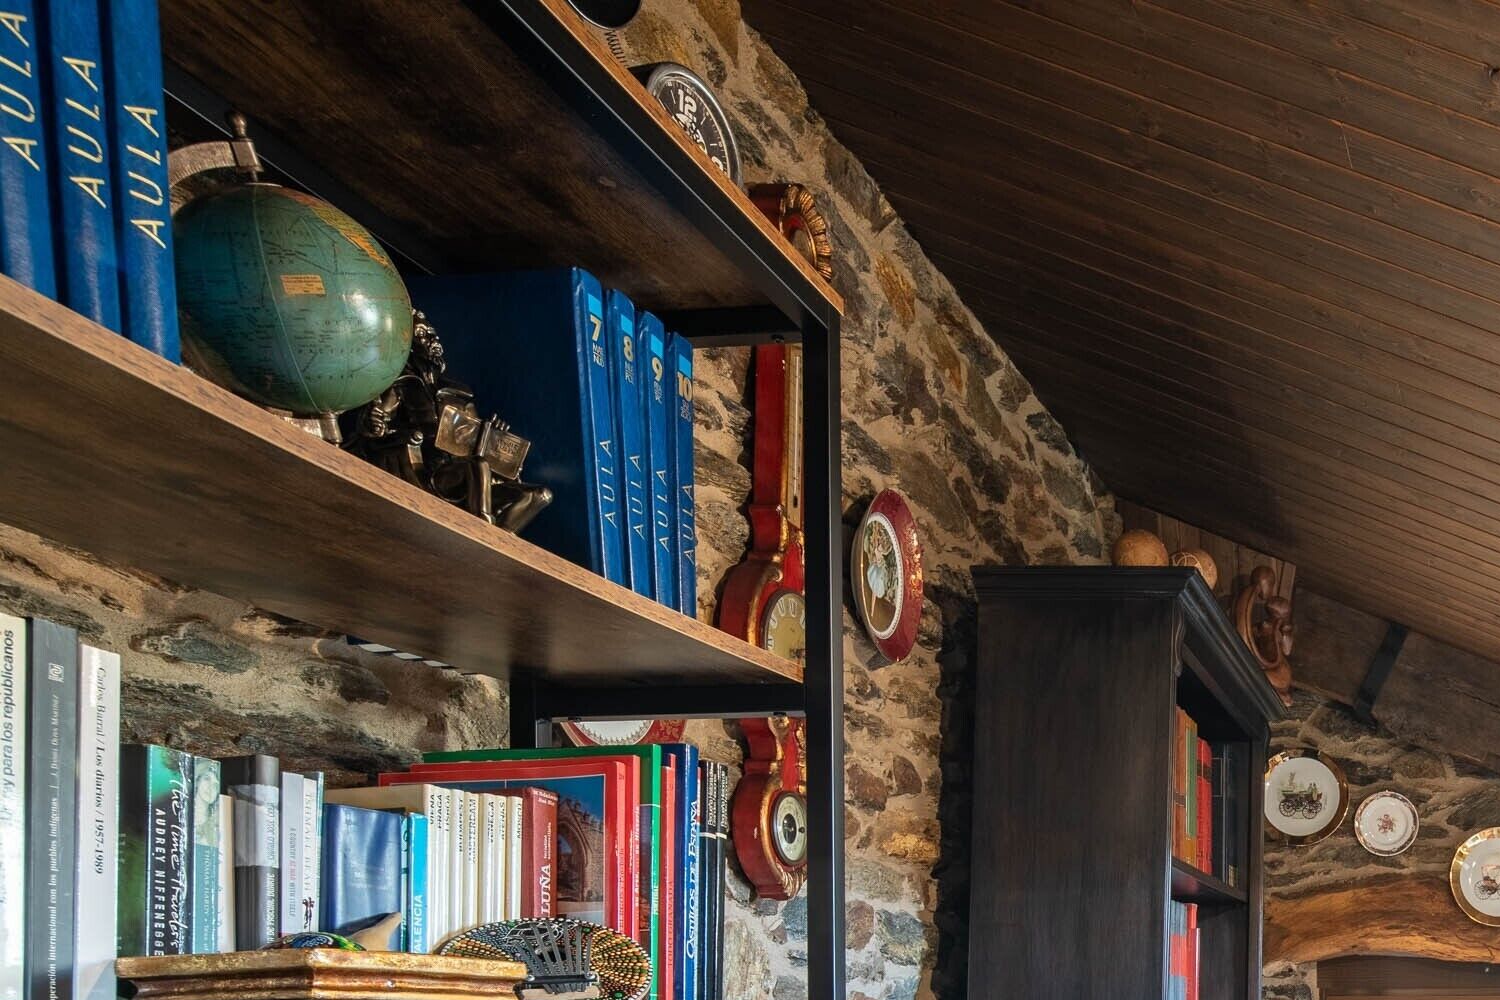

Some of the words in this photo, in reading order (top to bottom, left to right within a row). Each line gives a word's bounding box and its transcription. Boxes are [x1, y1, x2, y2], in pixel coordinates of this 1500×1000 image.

[0, 12, 40, 171] AULA
[677, 88, 698, 120] 12
[62, 56, 106, 208] AULA
[123, 105, 166, 249] AULA
[590, 314, 602, 342] 7
[623, 336, 634, 362] 8
[652, 357, 663, 382] 9
[677, 371, 692, 402] 10
[600, 440, 617, 528] AULA
[629, 455, 646, 540] AULA
[656, 470, 670, 553] AULA
[682, 485, 695, 566] AULA
[1, 630, 16, 719] republicanos
[96, 667, 107, 699] Carlos
[1, 723, 12, 742] los
[95, 705, 106, 736] Barral
[3, 745, 16, 776] para
[95, 747, 105, 767] Los
[95, 769, 105, 808] diarios
[168, 776, 189, 816] The
[48, 796, 60, 837] indígenas
[154, 808, 166, 863] AUDREY
[48, 840, 59, 873] pueblos
[94, 818, 105, 874] 1957-1989
[168, 823, 188, 868] Time
[47, 874, 56, 886] los
[48, 889, 56, 904] con
[539, 864, 551, 915] LUÑA
[47, 906, 57, 961] internacional
